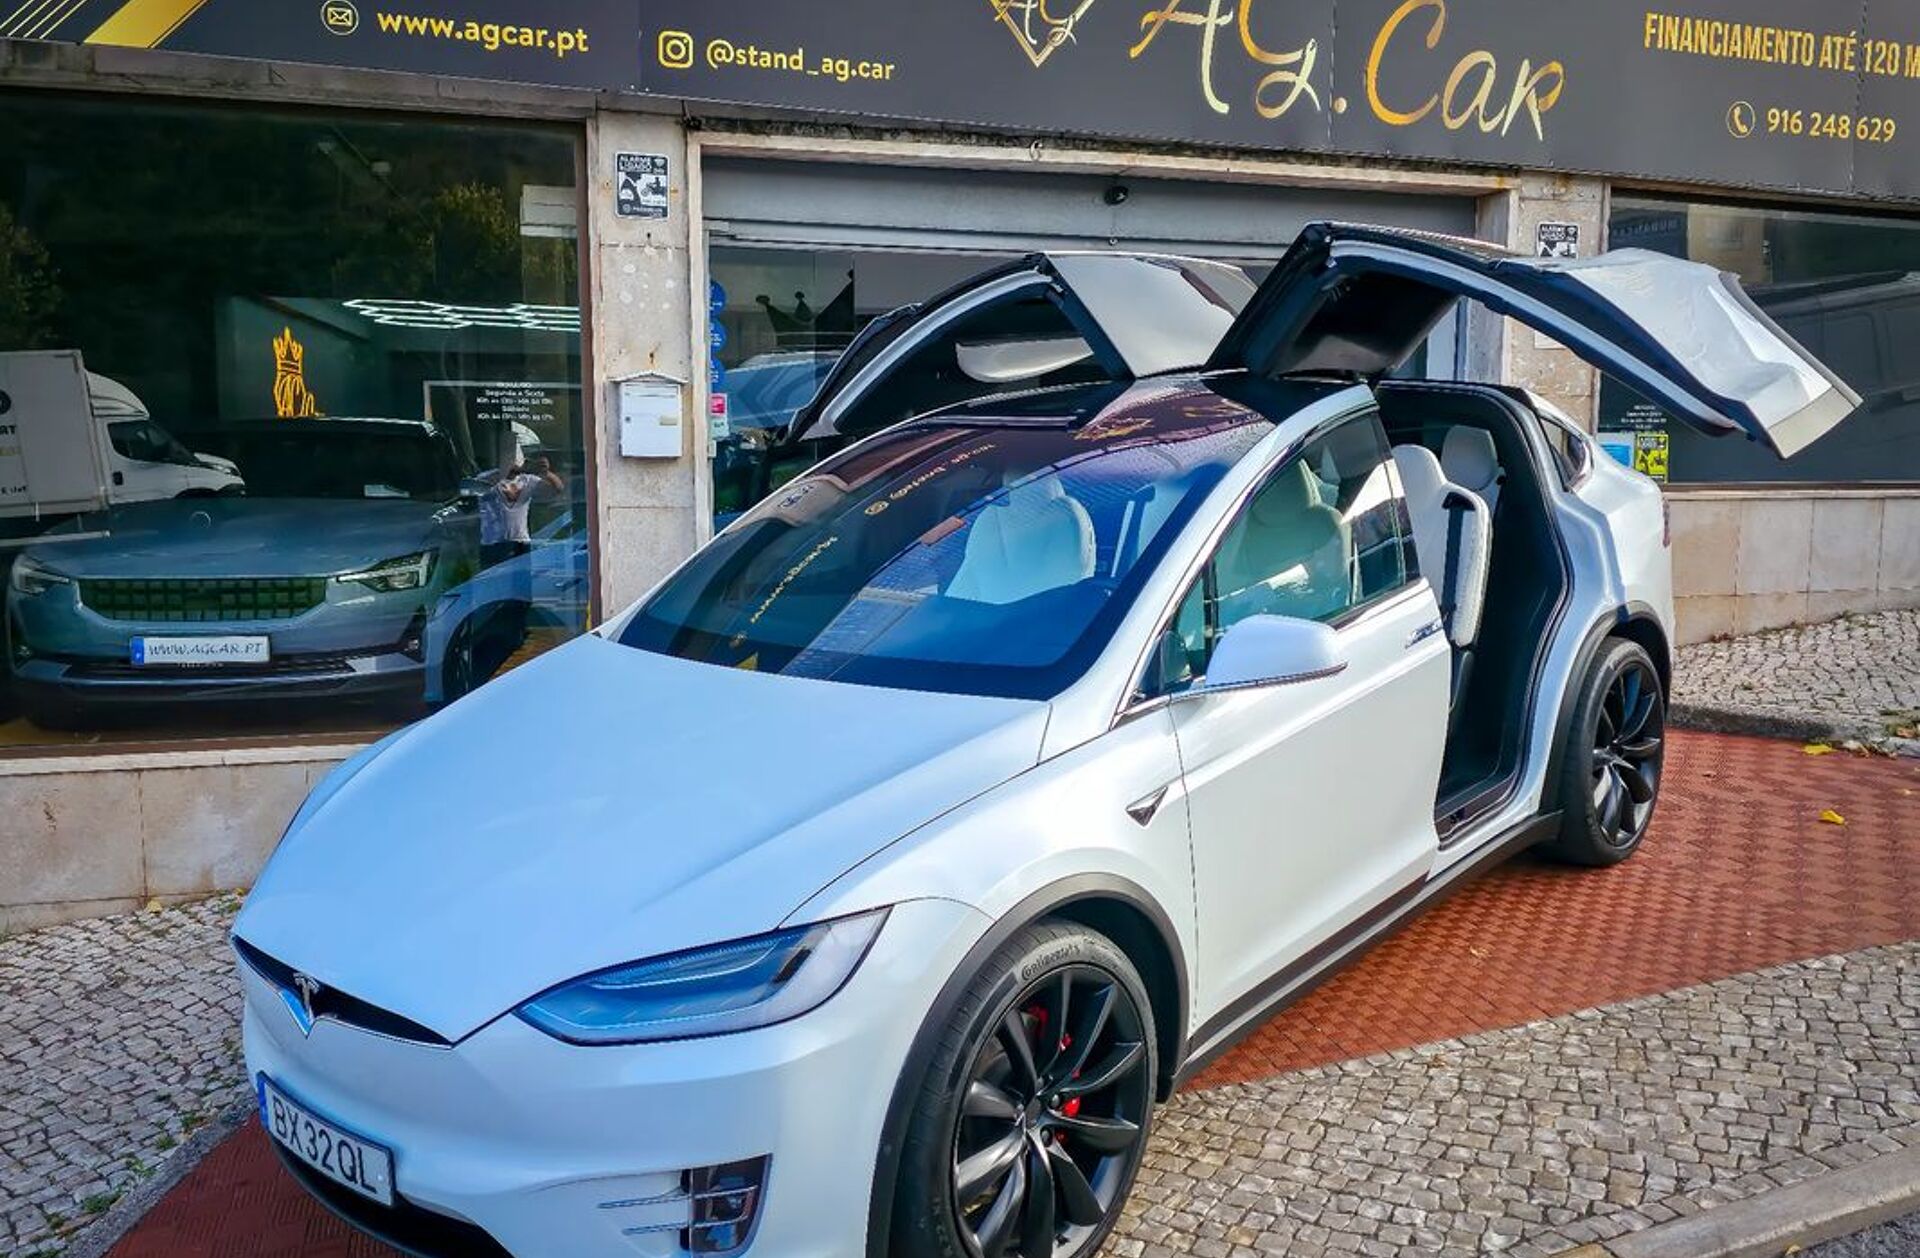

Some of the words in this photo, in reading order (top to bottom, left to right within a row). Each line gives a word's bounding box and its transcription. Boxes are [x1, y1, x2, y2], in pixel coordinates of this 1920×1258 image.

[377, 12, 589, 58] www.agcar.pt
[1644, 12, 1815, 67] FINANCIAMENTO
[1818, 31, 1857, 71] ATÉ
[1863, 39, 1901, 76] 120
[706, 39, 895, 82] @stand_ag.car
[1767, 108, 1803, 134] 916
[1810, 112, 1851, 139] 248
[1856, 117, 1896, 143] 629
